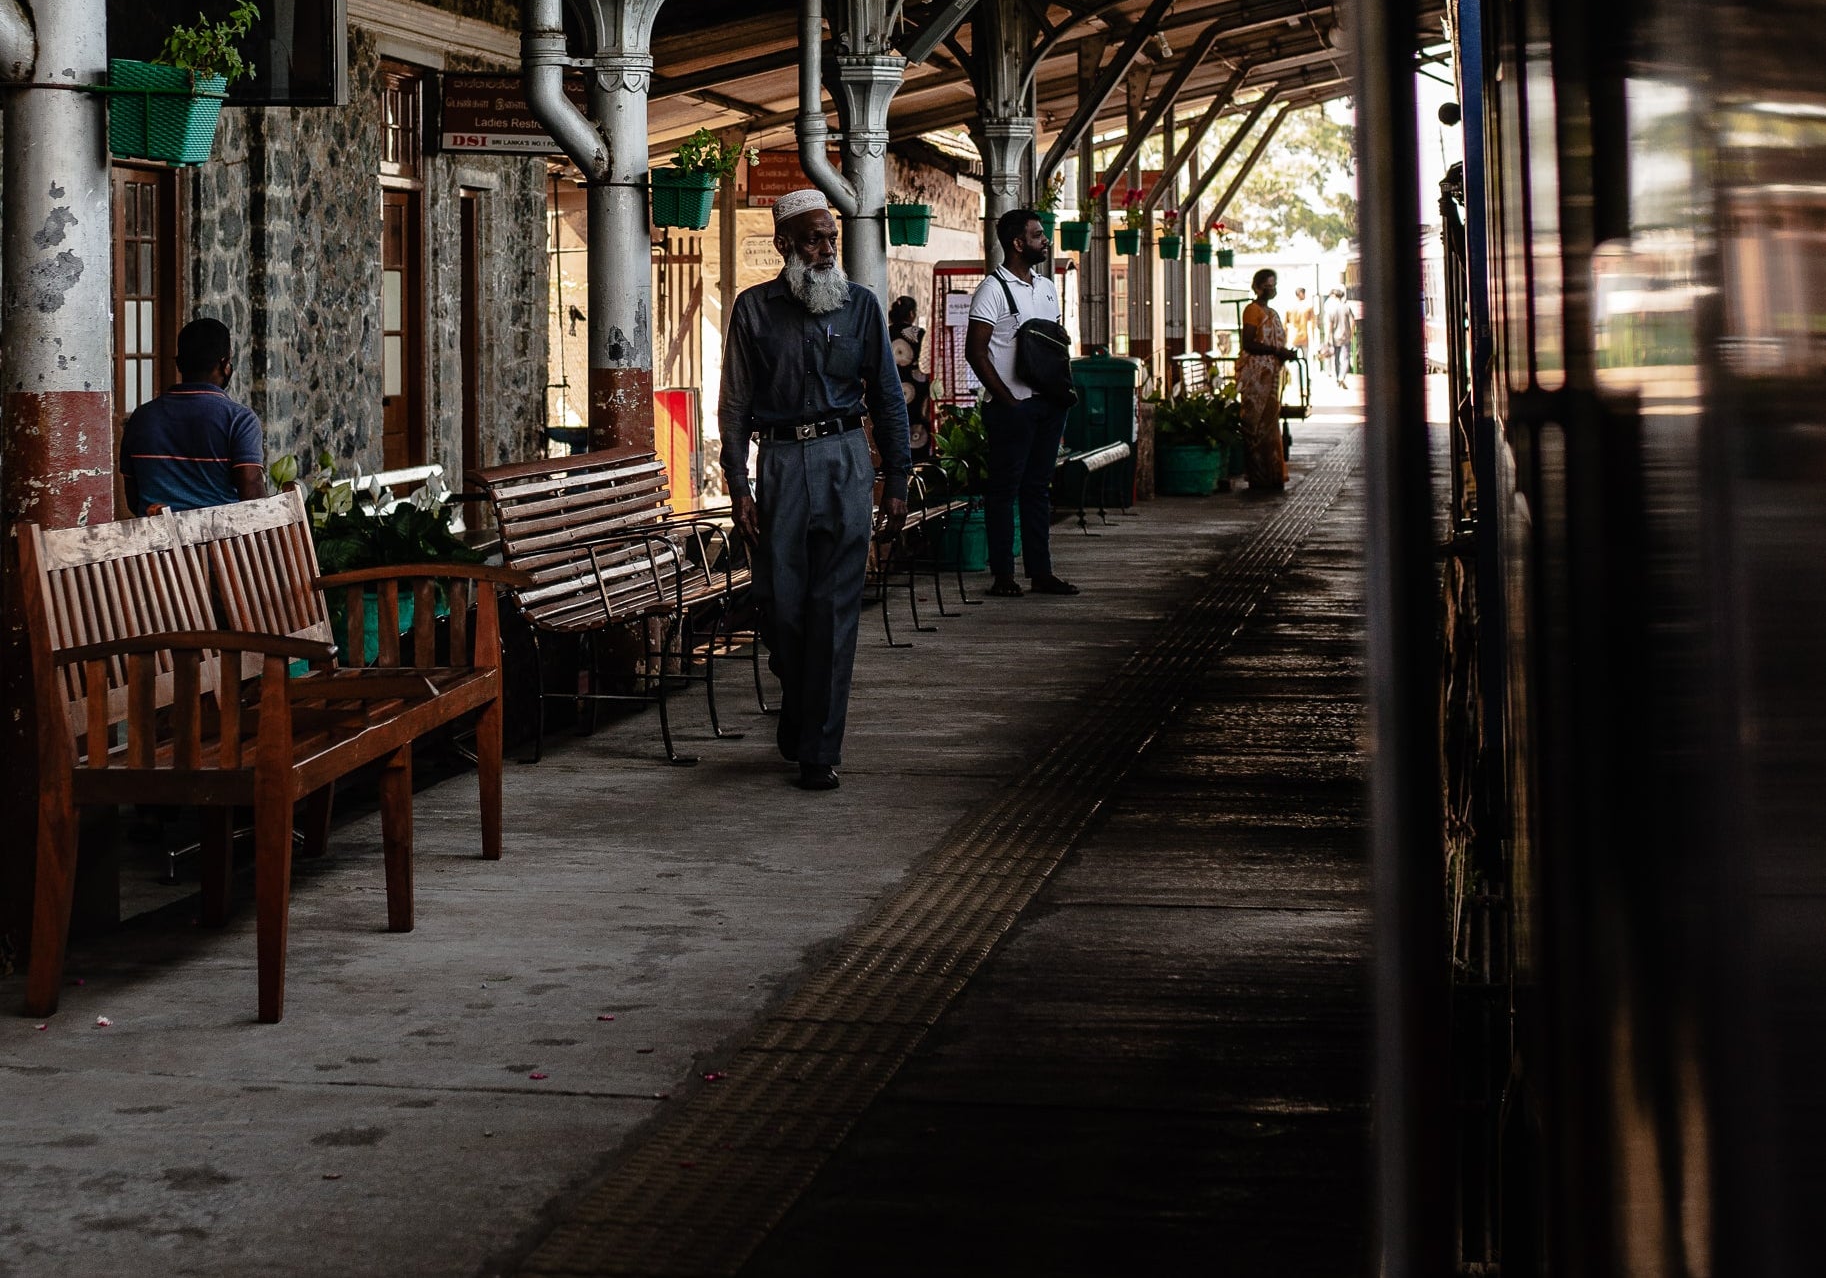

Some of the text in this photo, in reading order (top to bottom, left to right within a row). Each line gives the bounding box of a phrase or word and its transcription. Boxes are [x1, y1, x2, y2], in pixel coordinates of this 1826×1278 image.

[474, 116, 509, 128] Ladies
[452, 135, 488, 147] DSI
[757, 197, 776, 205] DS
[755, 258, 783, 266] LADIE
